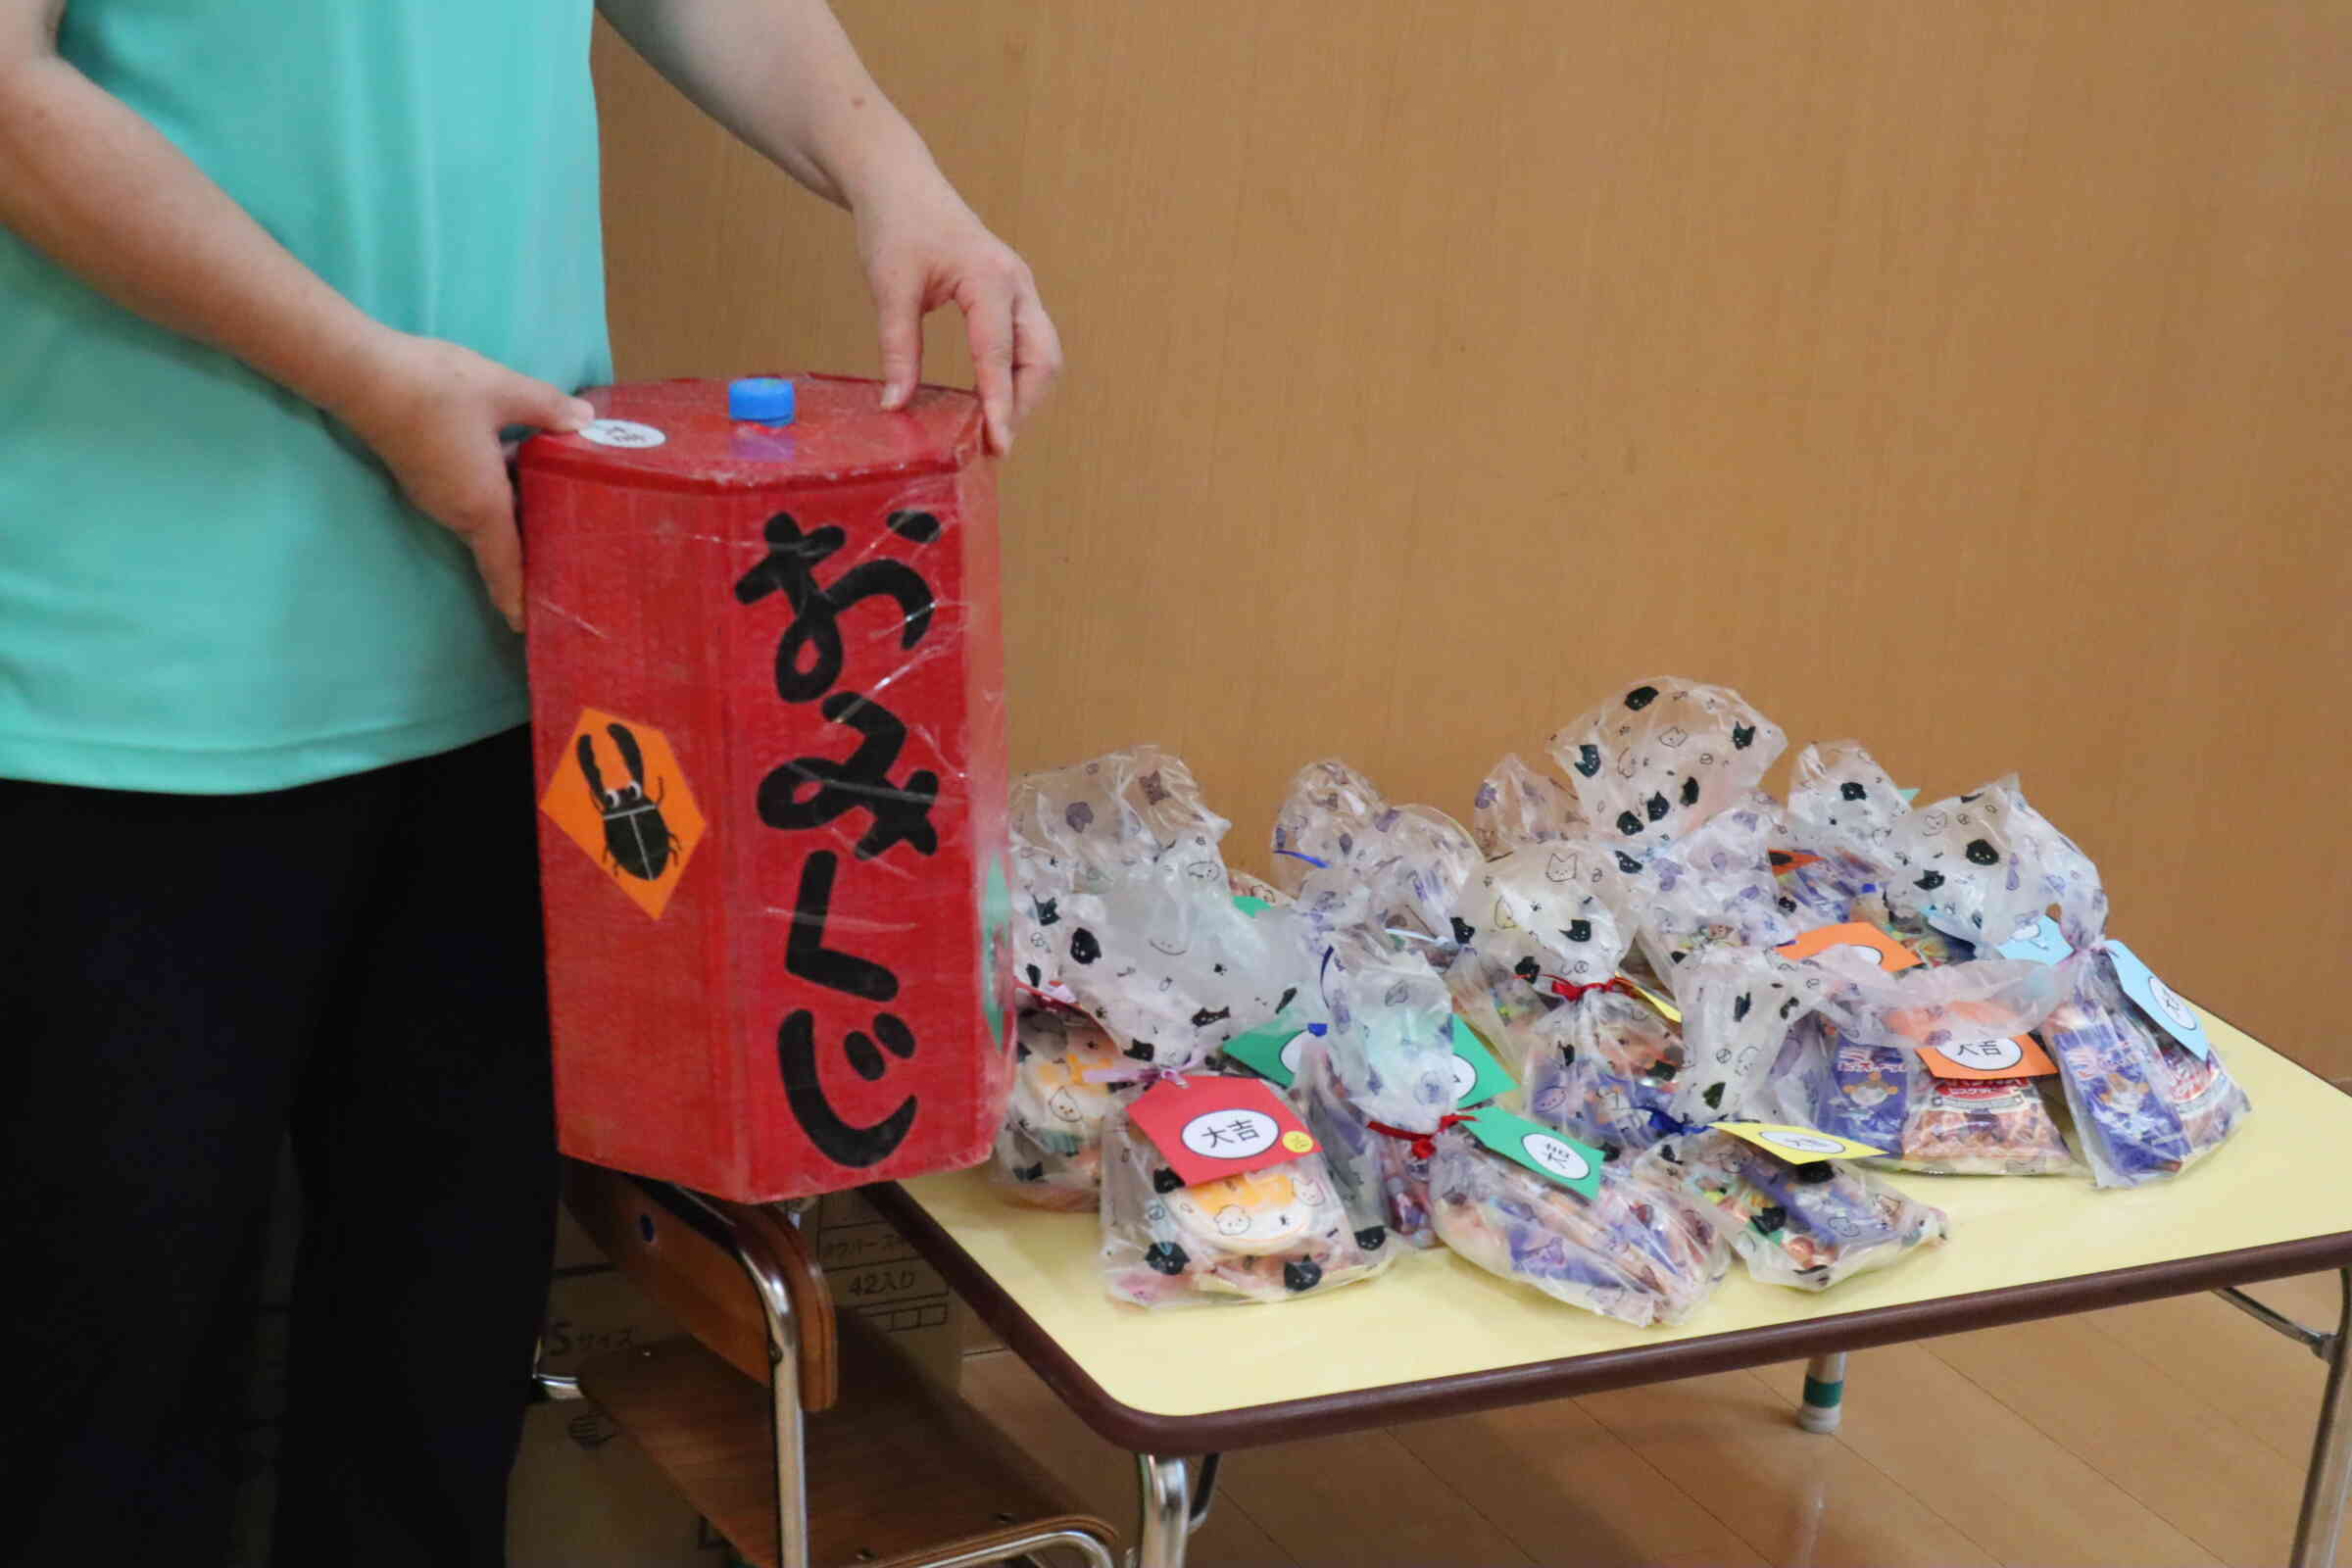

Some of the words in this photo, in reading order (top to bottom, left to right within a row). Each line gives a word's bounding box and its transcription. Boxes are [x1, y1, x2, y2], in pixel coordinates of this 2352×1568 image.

[735, 510, 941, 1169] おみくじ
[1200, 1118, 1261, 1149] 大吉
